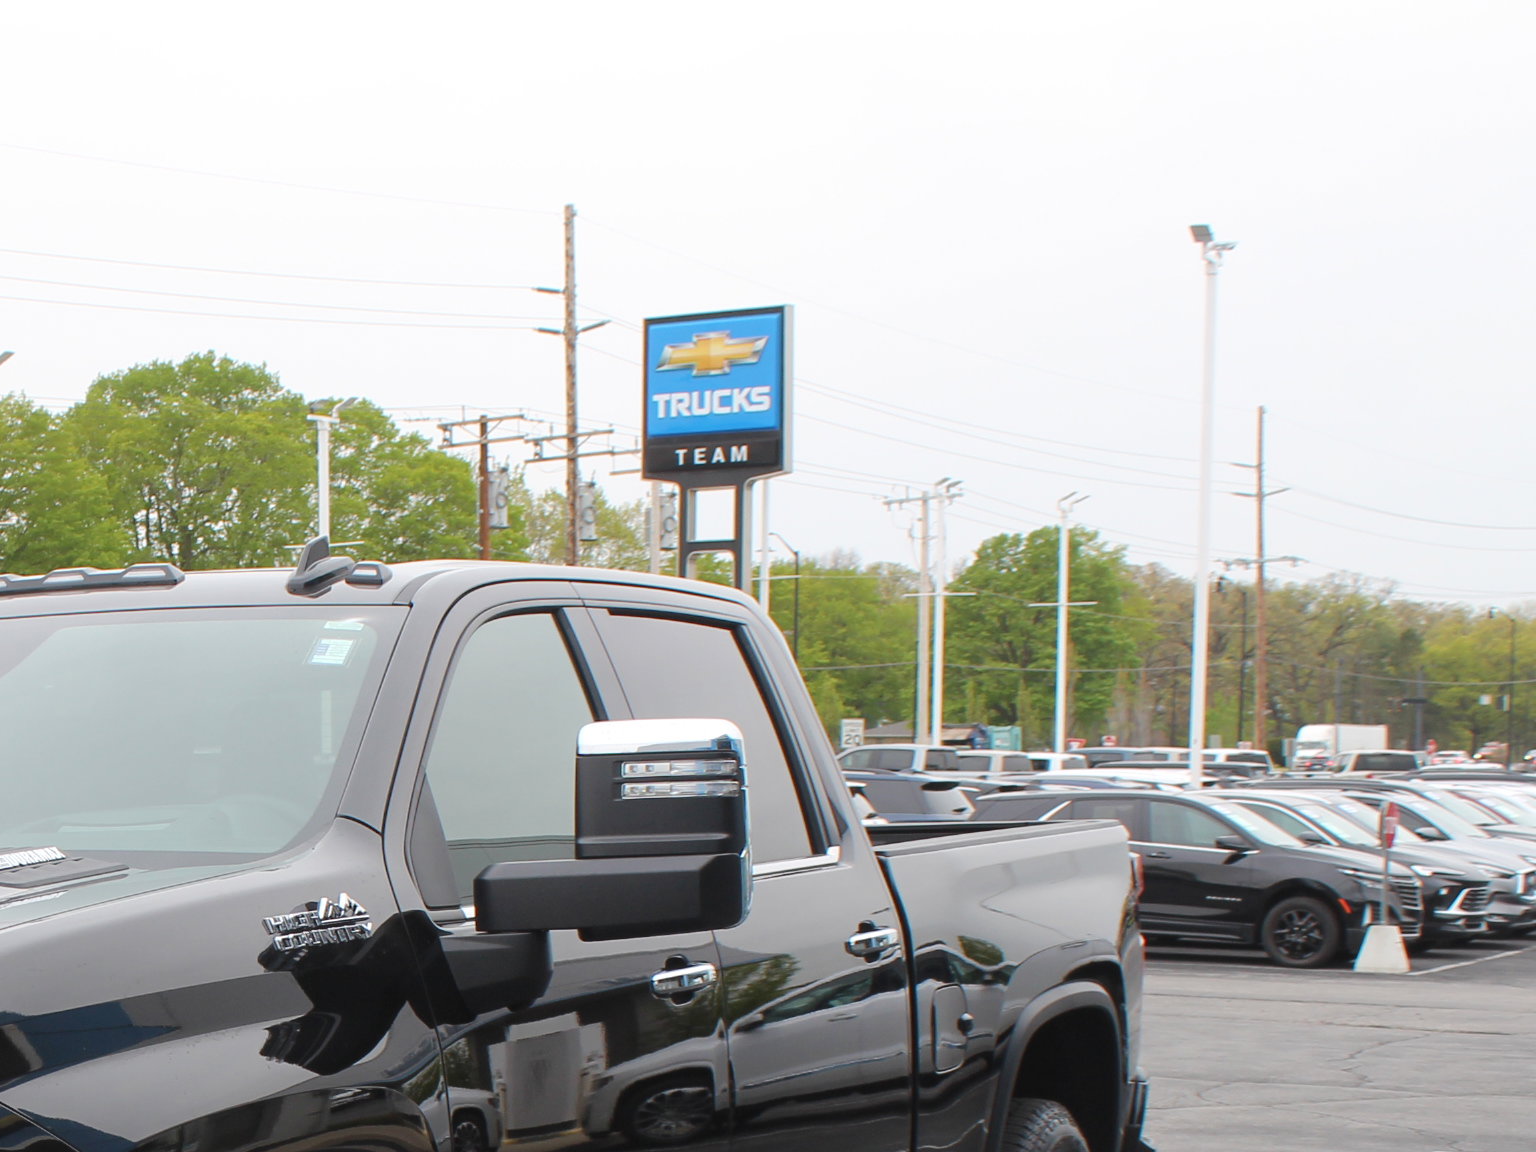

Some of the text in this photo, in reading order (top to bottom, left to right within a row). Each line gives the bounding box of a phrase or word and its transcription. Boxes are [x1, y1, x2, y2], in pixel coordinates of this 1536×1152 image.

[652, 385, 772, 419] TRUCKS
[674, 444, 750, 467] TEAM
[844, 733, 861, 747] 20
[273, 922, 373, 952] COUNTRY
